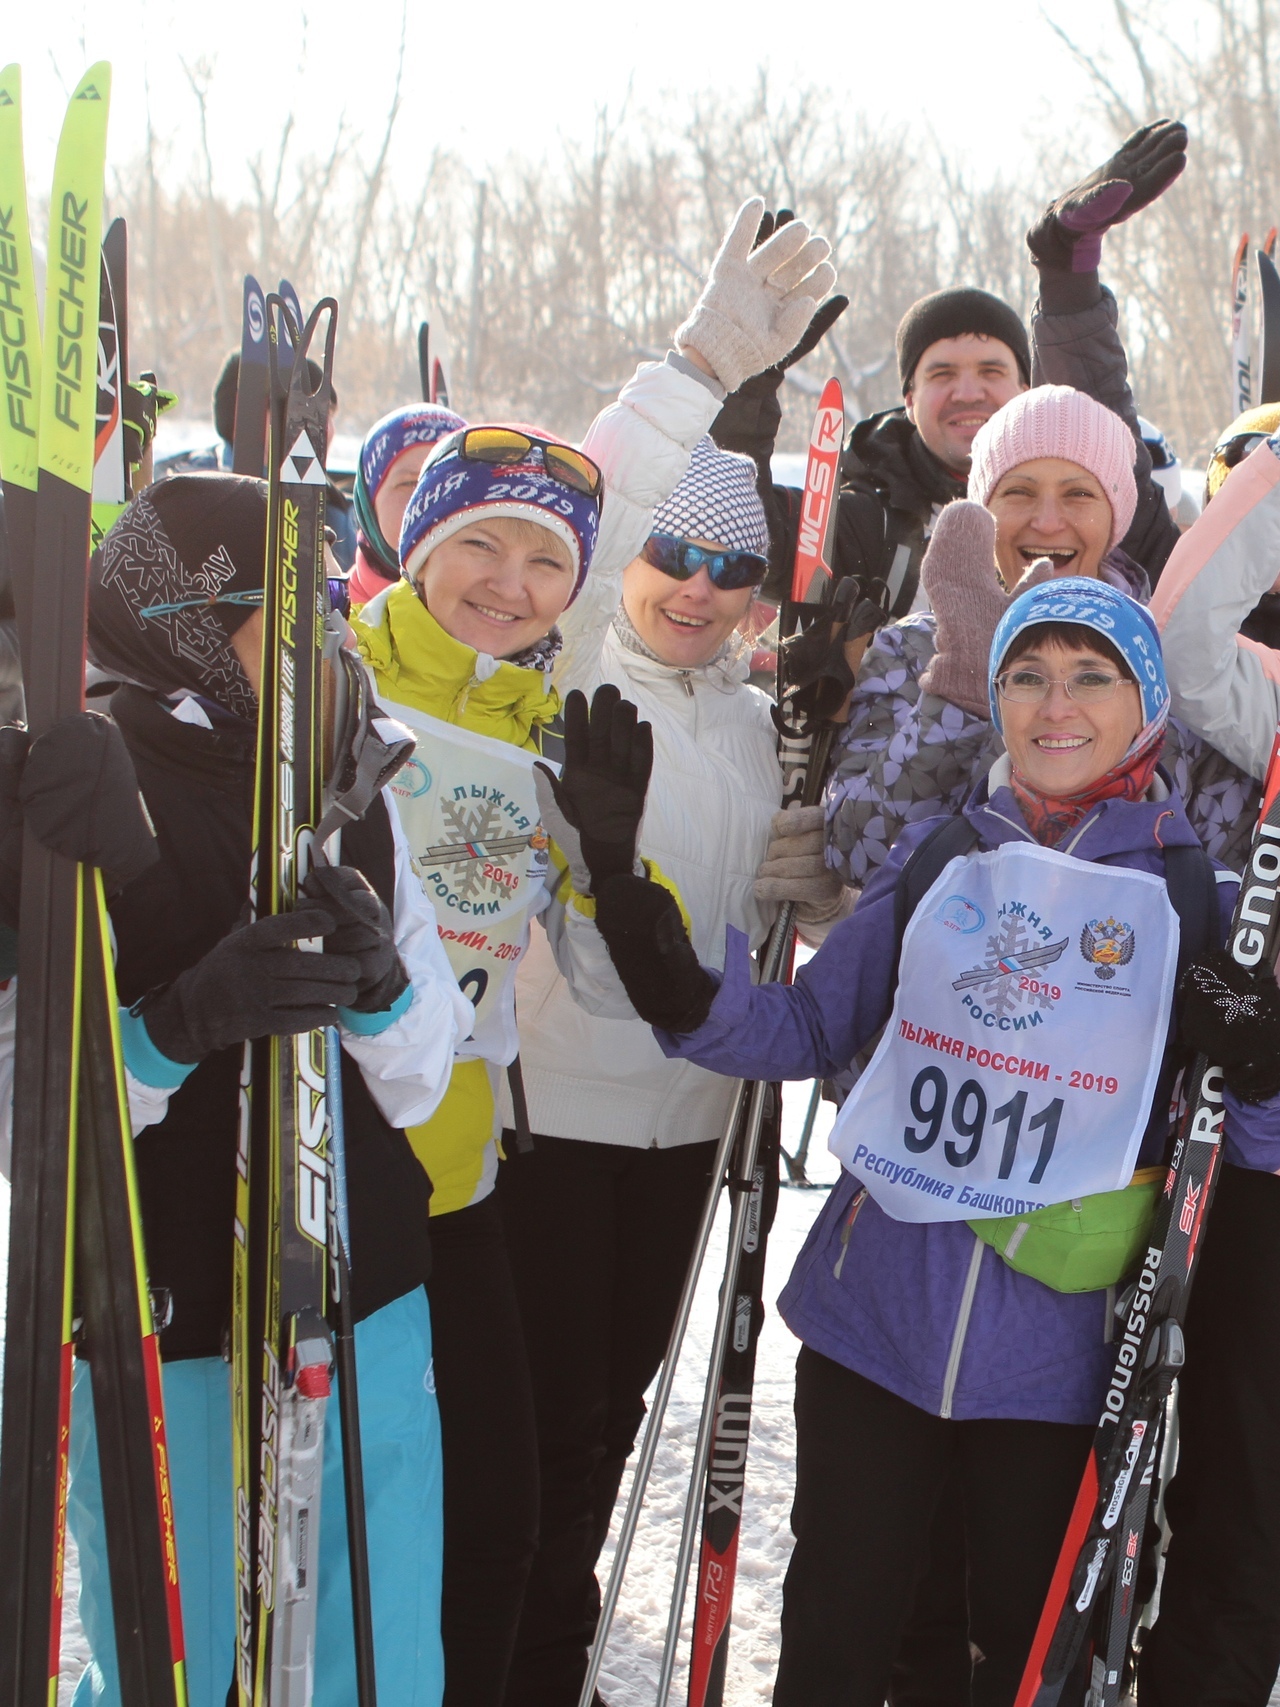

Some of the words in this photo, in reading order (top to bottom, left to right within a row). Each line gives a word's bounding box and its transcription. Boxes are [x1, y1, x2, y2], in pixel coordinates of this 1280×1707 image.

[55, 191, 88, 432] FISCHER
[51, 454, 82, 474] PLUS
[484, 483, 575, 516] 2019
[798, 456, 831, 557] WCS
[281, 498, 301, 650] FISCHER
[1027, 603, 1116, 631] 2019
[281, 650, 296, 698] LITE
[280, 692, 295, 762] CARBON
[453, 784, 531, 832] ЛЫЖНЯ
[427, 872, 501, 916] РОССИИ
[483, 863, 519, 890] 2019
[997, 901, 1054, 941] ЫЖНЯ
[494, 942, 521, 961] 2019
[1018, 975, 1062, 1001] 2019
[961, 993, 1044, 1032] РОССИИ
[898, 1018, 965, 1059] ЛЫЖНЯ
[966, 1044, 1051, 1082] РОССИИ
[1068, 1070, 1119, 1095] 2019
[903, 1065, 1065, 1185] 9911
[852, 1143, 955, 1201] Республика
[1171, 1137, 1185, 1170] 163
[1178, 1174, 1202, 1236] SK
[1098, 1246, 1163, 1429] ROSSIGNOL
[256, 1340, 279, 1613] FISCHER
[707, 1393, 753, 1517] XIUM
[56, 1452, 68, 1599] FISCHER
[157, 1443, 178, 1586] FISCHER
[1126, 1528, 1140, 1558] SK
[237, 1486, 251, 1699] FISCHER
[704, 1560, 723, 1604] 173
[1121, 1556, 1135, 1588] 163
[704, 1604, 718, 1646] SKATING
